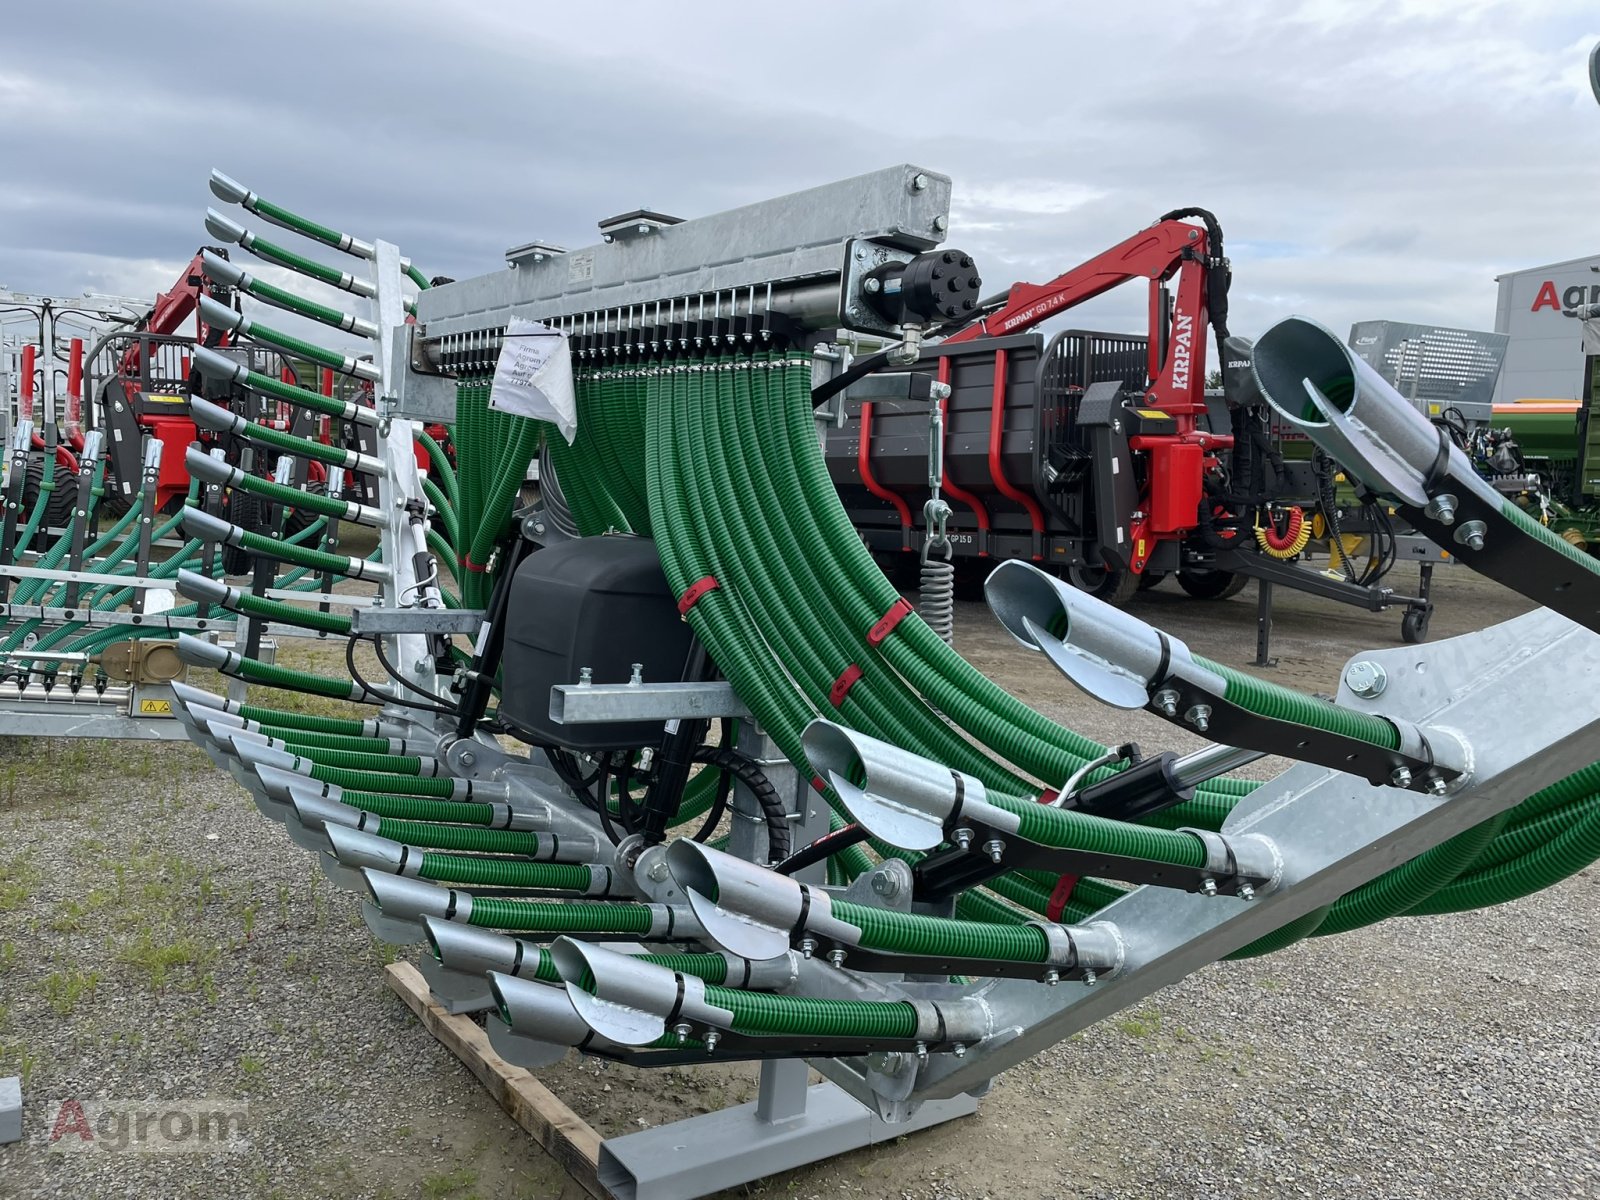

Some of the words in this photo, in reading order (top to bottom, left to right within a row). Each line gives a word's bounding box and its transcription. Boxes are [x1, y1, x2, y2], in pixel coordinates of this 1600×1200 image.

[1004, 308, 1034, 330] KRPAN
[519, 344, 540, 355] Firma
[1172, 313, 1193, 390] KRPAN
